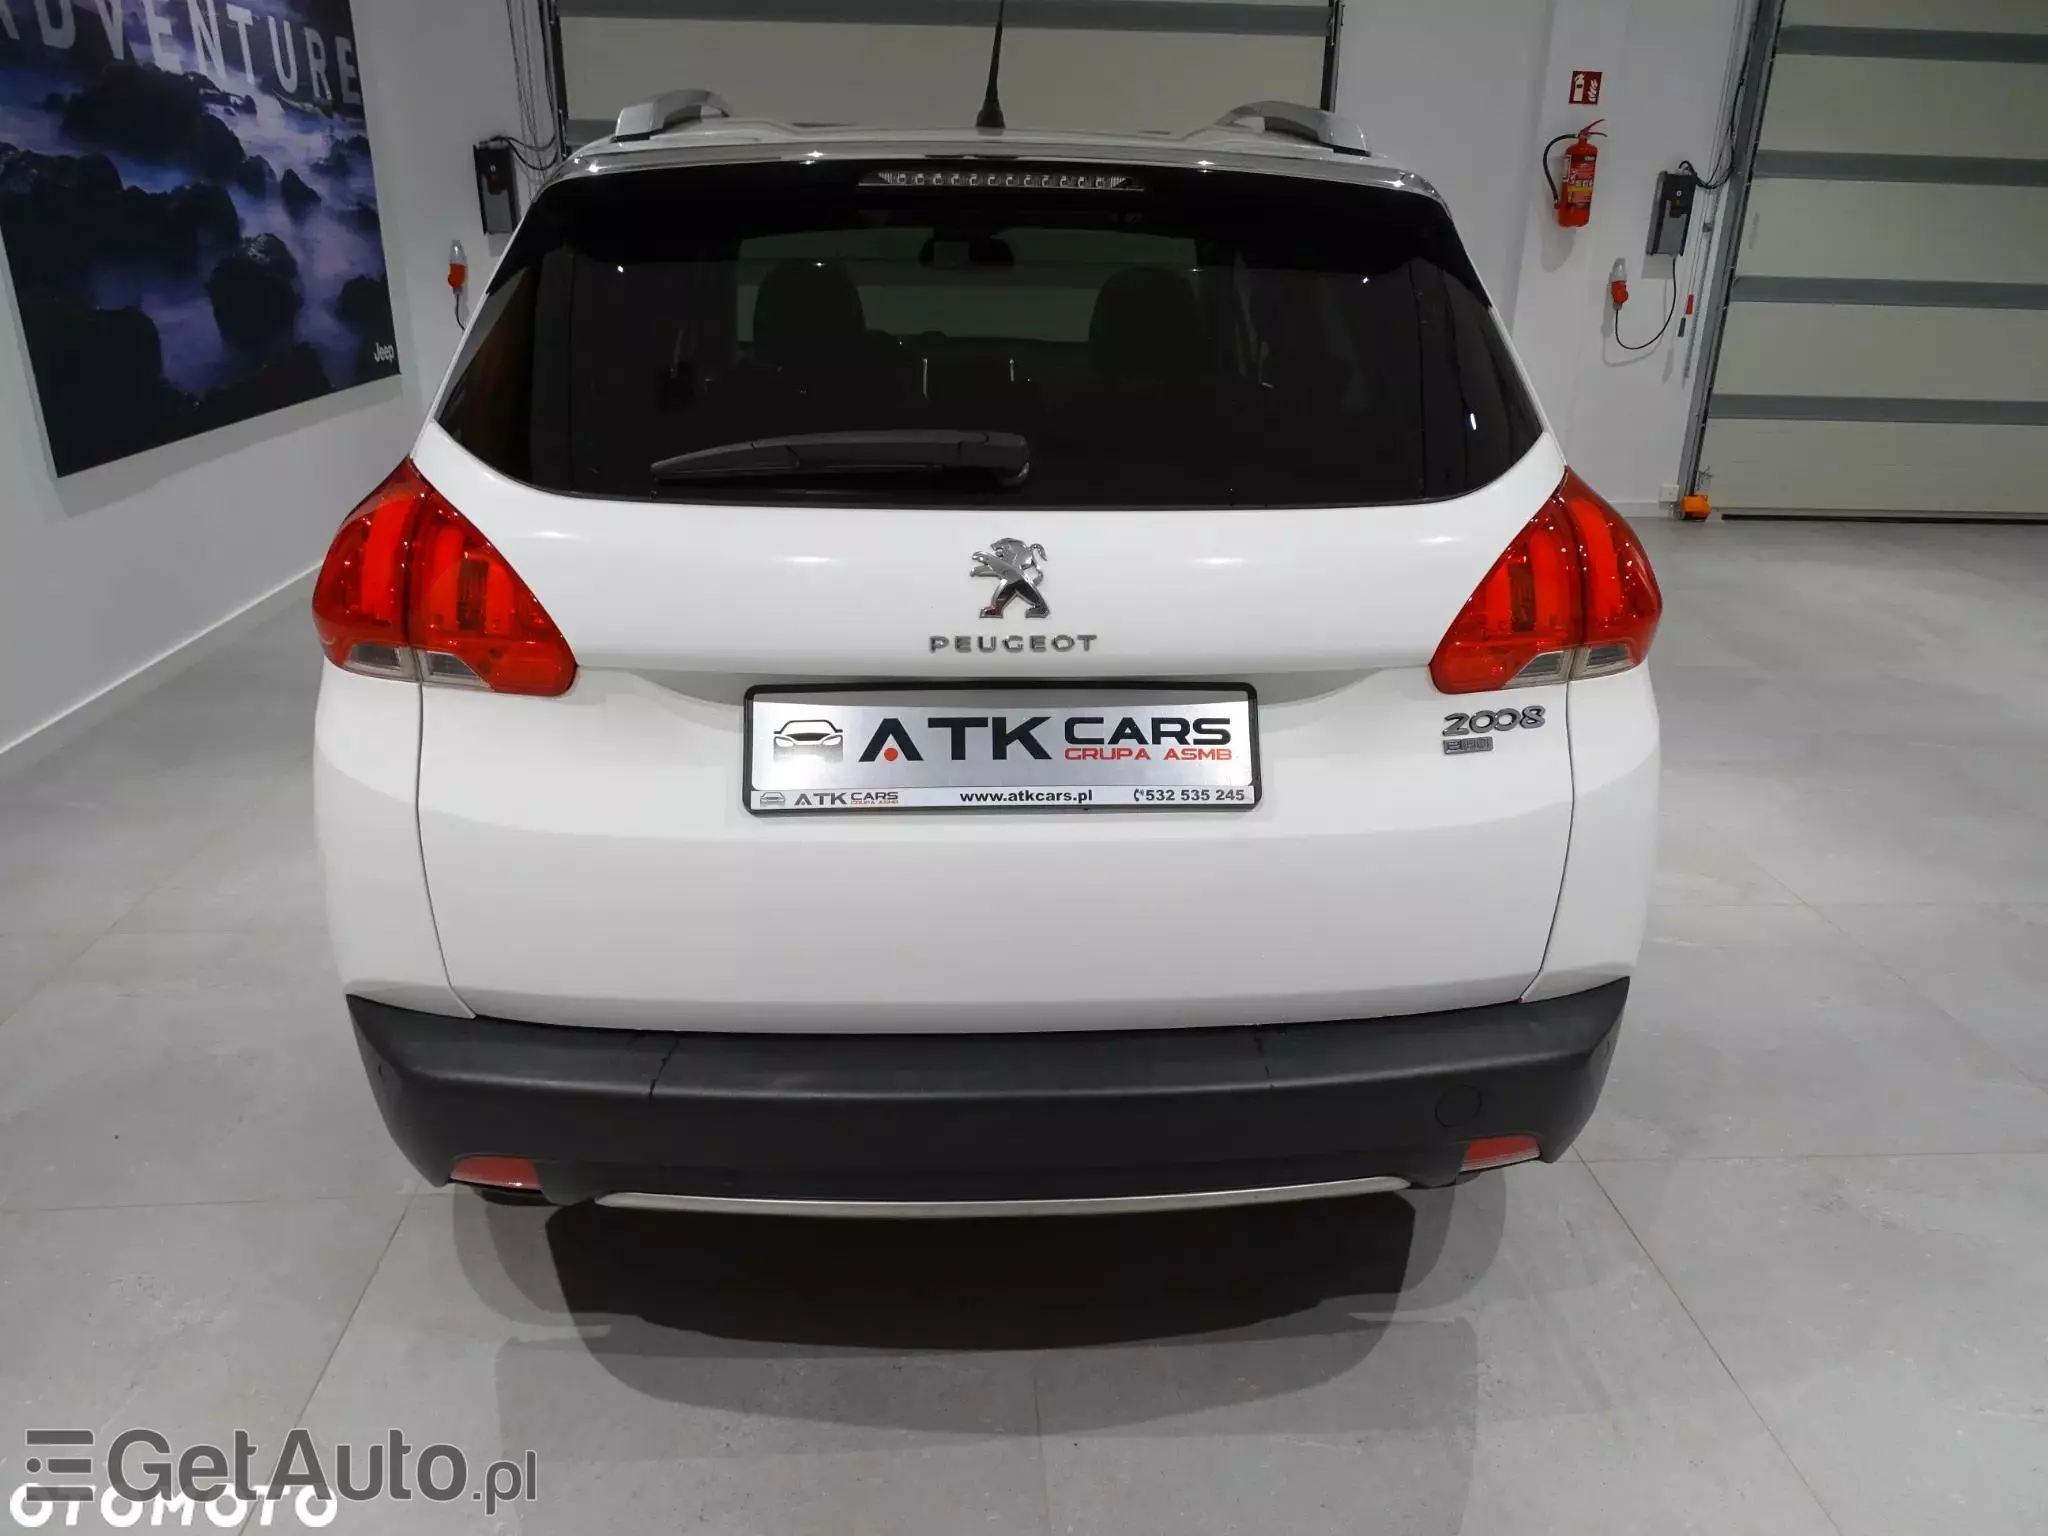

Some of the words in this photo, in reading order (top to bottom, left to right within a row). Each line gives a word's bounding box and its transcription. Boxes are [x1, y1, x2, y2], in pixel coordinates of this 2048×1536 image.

[373, 341, 395, 364] Jeep
[929, 635, 1098, 653] PEUGEOT
[1442, 705, 1546, 736] 2008
[858, 717, 1053, 762] ATK
[1065, 717, 1231, 745] CARS
[1065, 748, 1151, 760] GRUPA
[1164, 748, 1233, 760] ASMB
[794, 792, 848, 806] ATK
[850, 791, 899, 801] CARS
[959, 789, 1093, 803] www.atkcars.pl
[1145, 789, 1175, 801] 532
[1180, 789, 1210, 801] 535
[1215, 789, 1245, 801] 245
